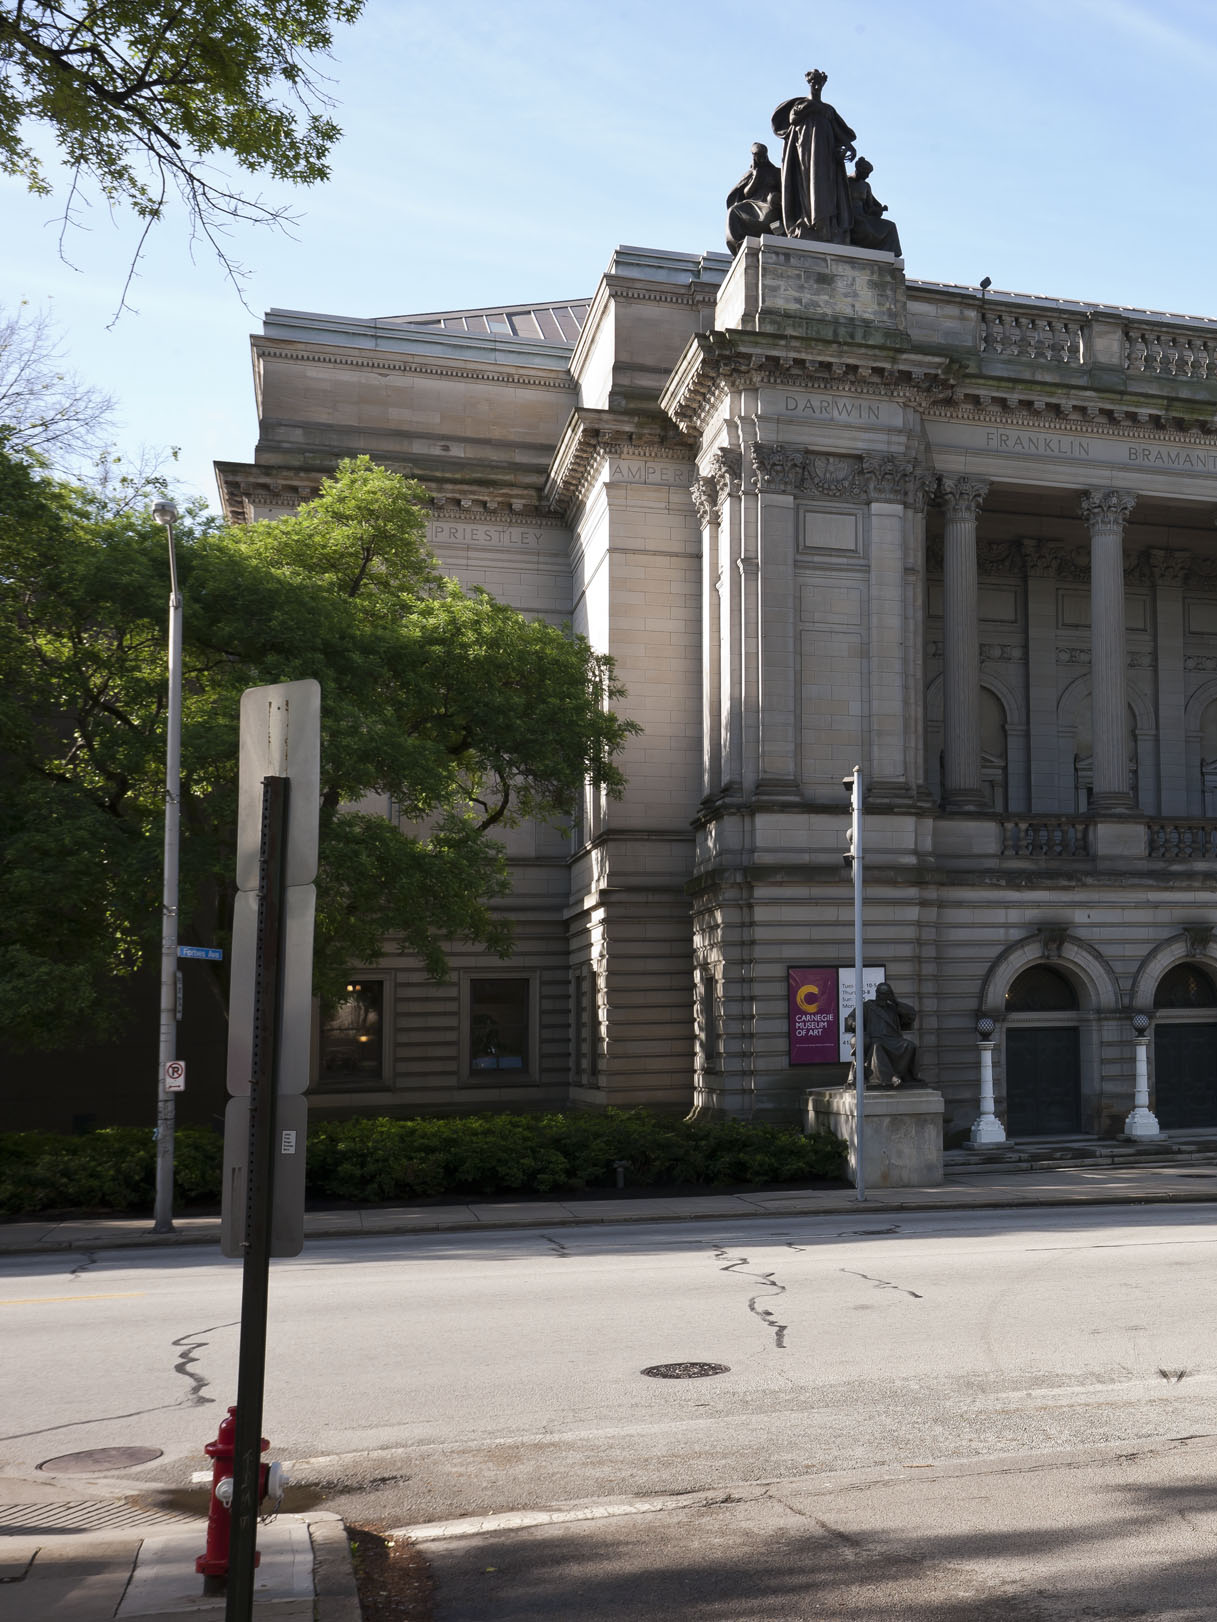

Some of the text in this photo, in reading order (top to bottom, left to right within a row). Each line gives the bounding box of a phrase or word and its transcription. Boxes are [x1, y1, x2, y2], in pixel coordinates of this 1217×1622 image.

[784, 395, 880, 420] DARWIN
[986, 432, 1090, 456] FRANKLIN
[434, 525, 543, 545] PRIESTLEY
